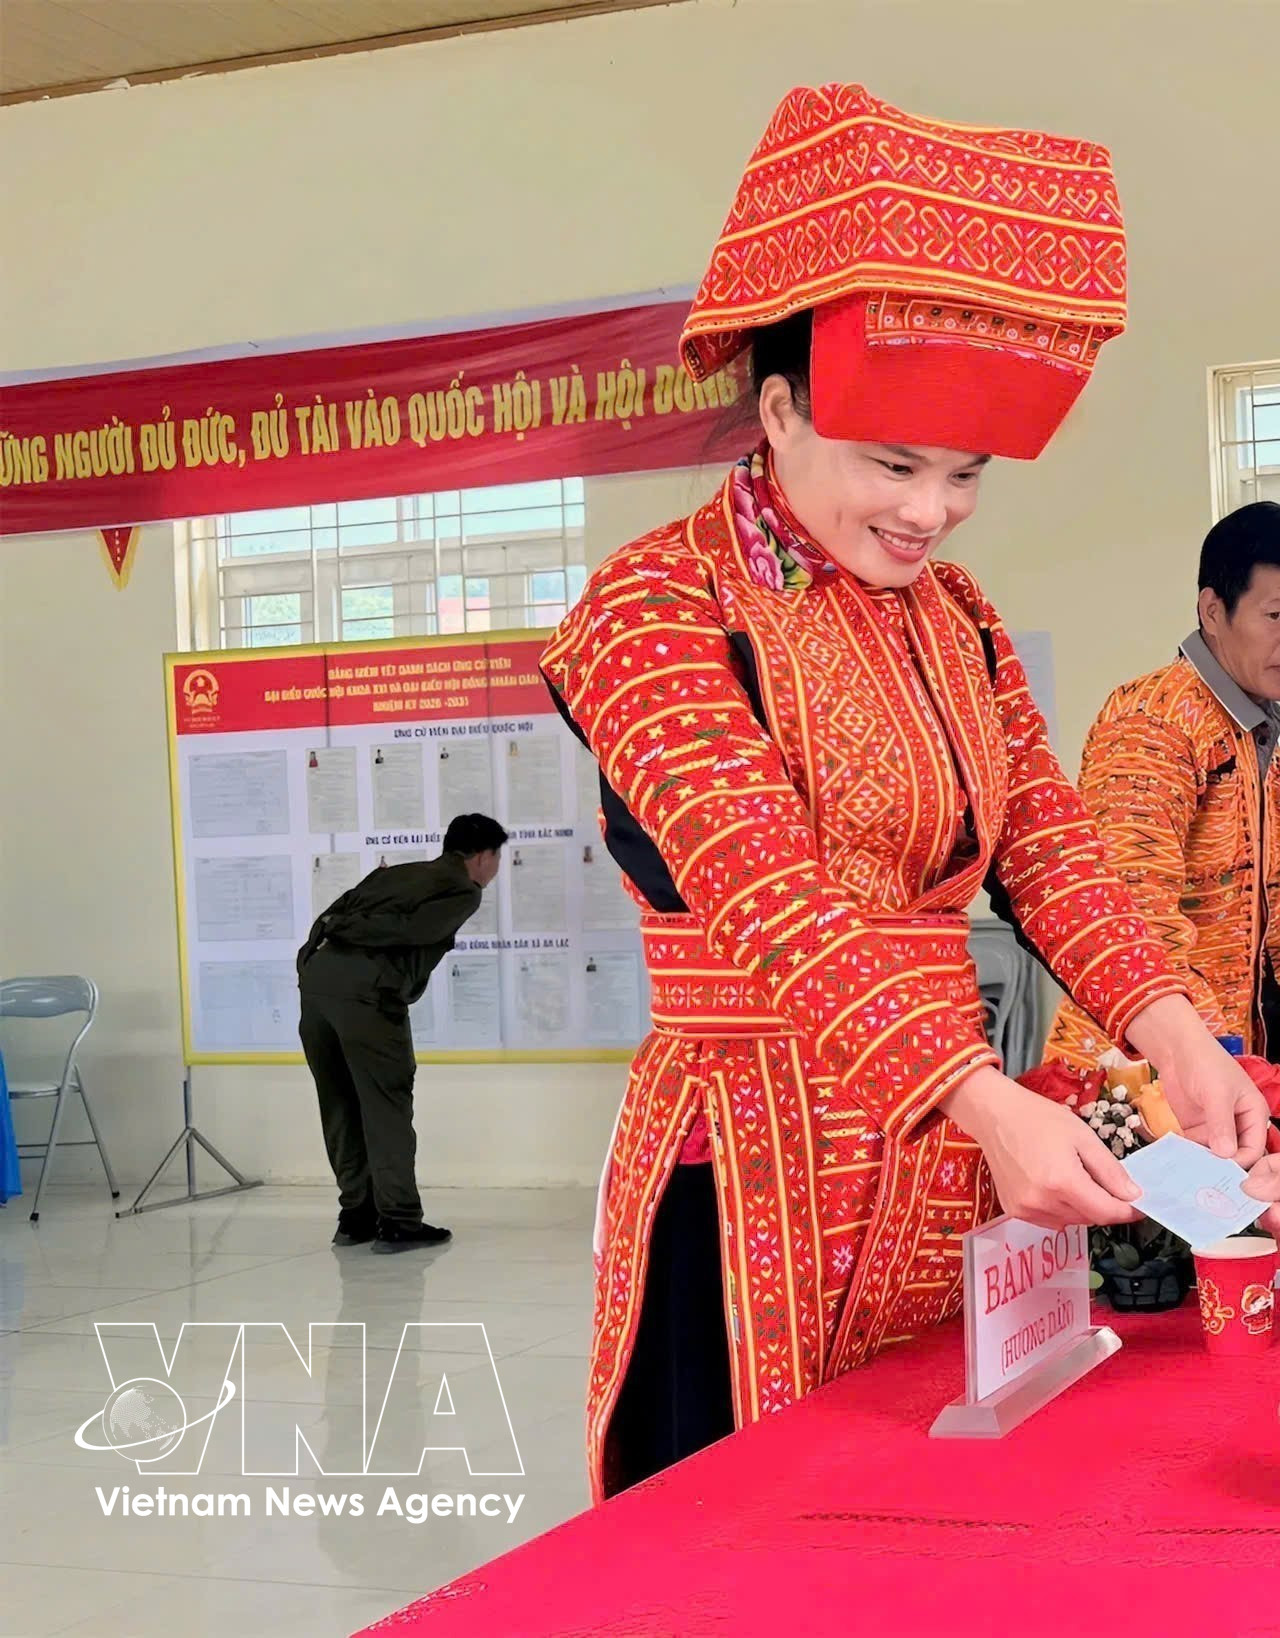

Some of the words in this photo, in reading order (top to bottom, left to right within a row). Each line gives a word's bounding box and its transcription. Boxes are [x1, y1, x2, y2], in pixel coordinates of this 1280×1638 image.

[54, 415, 135, 481] NGƯỜI
[139, 404, 177, 472] ĐỦ
[182, 406, 246, 469] ĐỨC,
[250, 392, 290, 460] ĐỦ
[295, 394, 340, 455] TÀI
[345, 388, 401, 450] VÀO
[407, 370, 485, 448] QUỐC
[491, 369, 542, 442] HỘI
[549, 363, 587, 426] VÀ
[594, 358, 646, 431] HỘI
[983, 1242, 1035, 1316] BÀN
